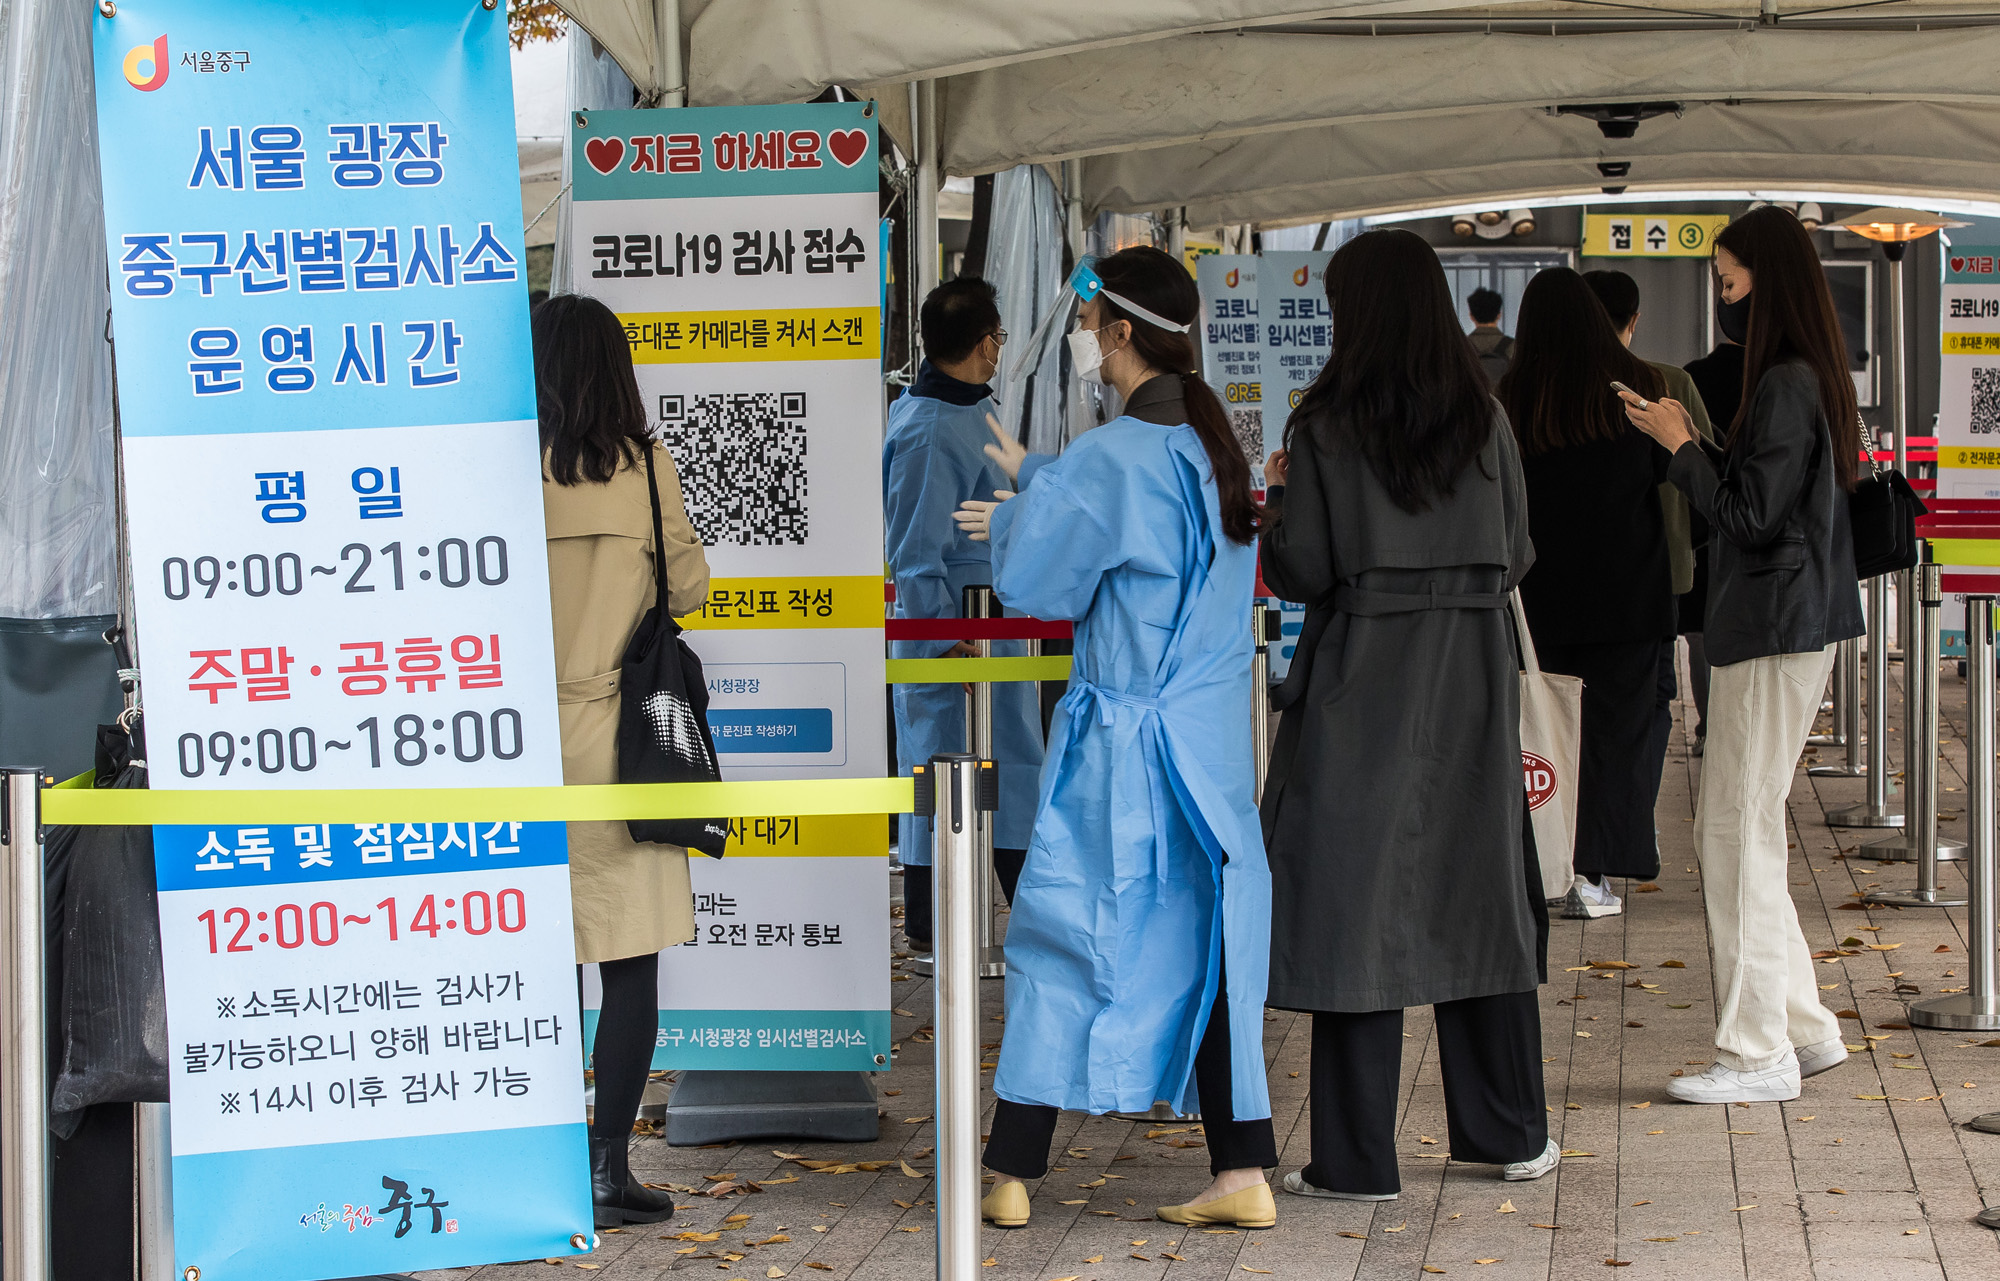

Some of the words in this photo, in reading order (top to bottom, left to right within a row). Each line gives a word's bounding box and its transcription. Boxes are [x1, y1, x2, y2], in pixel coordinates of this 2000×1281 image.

[180, 50, 251, 74] 서울중구
[187, 125, 306, 191] 서울
[327, 121, 448, 189] 광장
[629, 133, 703, 175] 지금
[712, 130, 823, 171] 하세요
[120, 223, 518, 298] 중구선별검사소
[591, 231, 722, 279] 코로나19
[731, 229, 795, 276] 검사
[803, 227, 866, 274] 접수
[1966, 256, 1994, 274] 지금
[1950, 298, 1999, 318] 코로나19
[623, 322, 684, 351] 휴대폰
[688, 319, 770, 350] 카메라를
[776, 317, 816, 348] 켜서
[822, 316, 863, 346] 스캔
[1207, 323, 1260, 344] 임시선별
[162, 535, 510, 601] 09:00~21:00
[788, 588, 833, 618] 작성
[708, 678, 760, 694] 시청광장
[177, 707, 524, 778] 09:00~18:00
[722, 725, 754, 737] 문진표
[756, 724, 798, 738] 작성하기
[195, 828, 275, 871] 소독
[294, 823, 334, 868] 및
[353, 821, 523, 864] 점심시간
[755, 816, 799, 846] 대기
[196, 888, 527, 954] 12:00~14:00
[707, 923, 747, 947] 오전
[754, 923, 795, 947] 문자
[801, 923, 843, 948] 통보
[435, 970, 526, 1009] 검사가
[183, 1030, 357, 1075] 불가능하오니
[371, 1025, 430, 1060] 양해
[443, 1013, 563, 1053] 바랍니다
[656, 1028, 685, 1047] 중구
[689, 1027, 752, 1048] 시청광장
[756, 1028, 867, 1049] 임시선별검사소
[328, 1075, 388, 1111] 이후
[401, 1070, 460, 1106] 검사
[473, 1065, 532, 1099] 가능
[299, 1202, 341, 1233] 서울의
[342, 1203, 384, 1234] 중심
[378, 1175, 449, 1239] 중구
